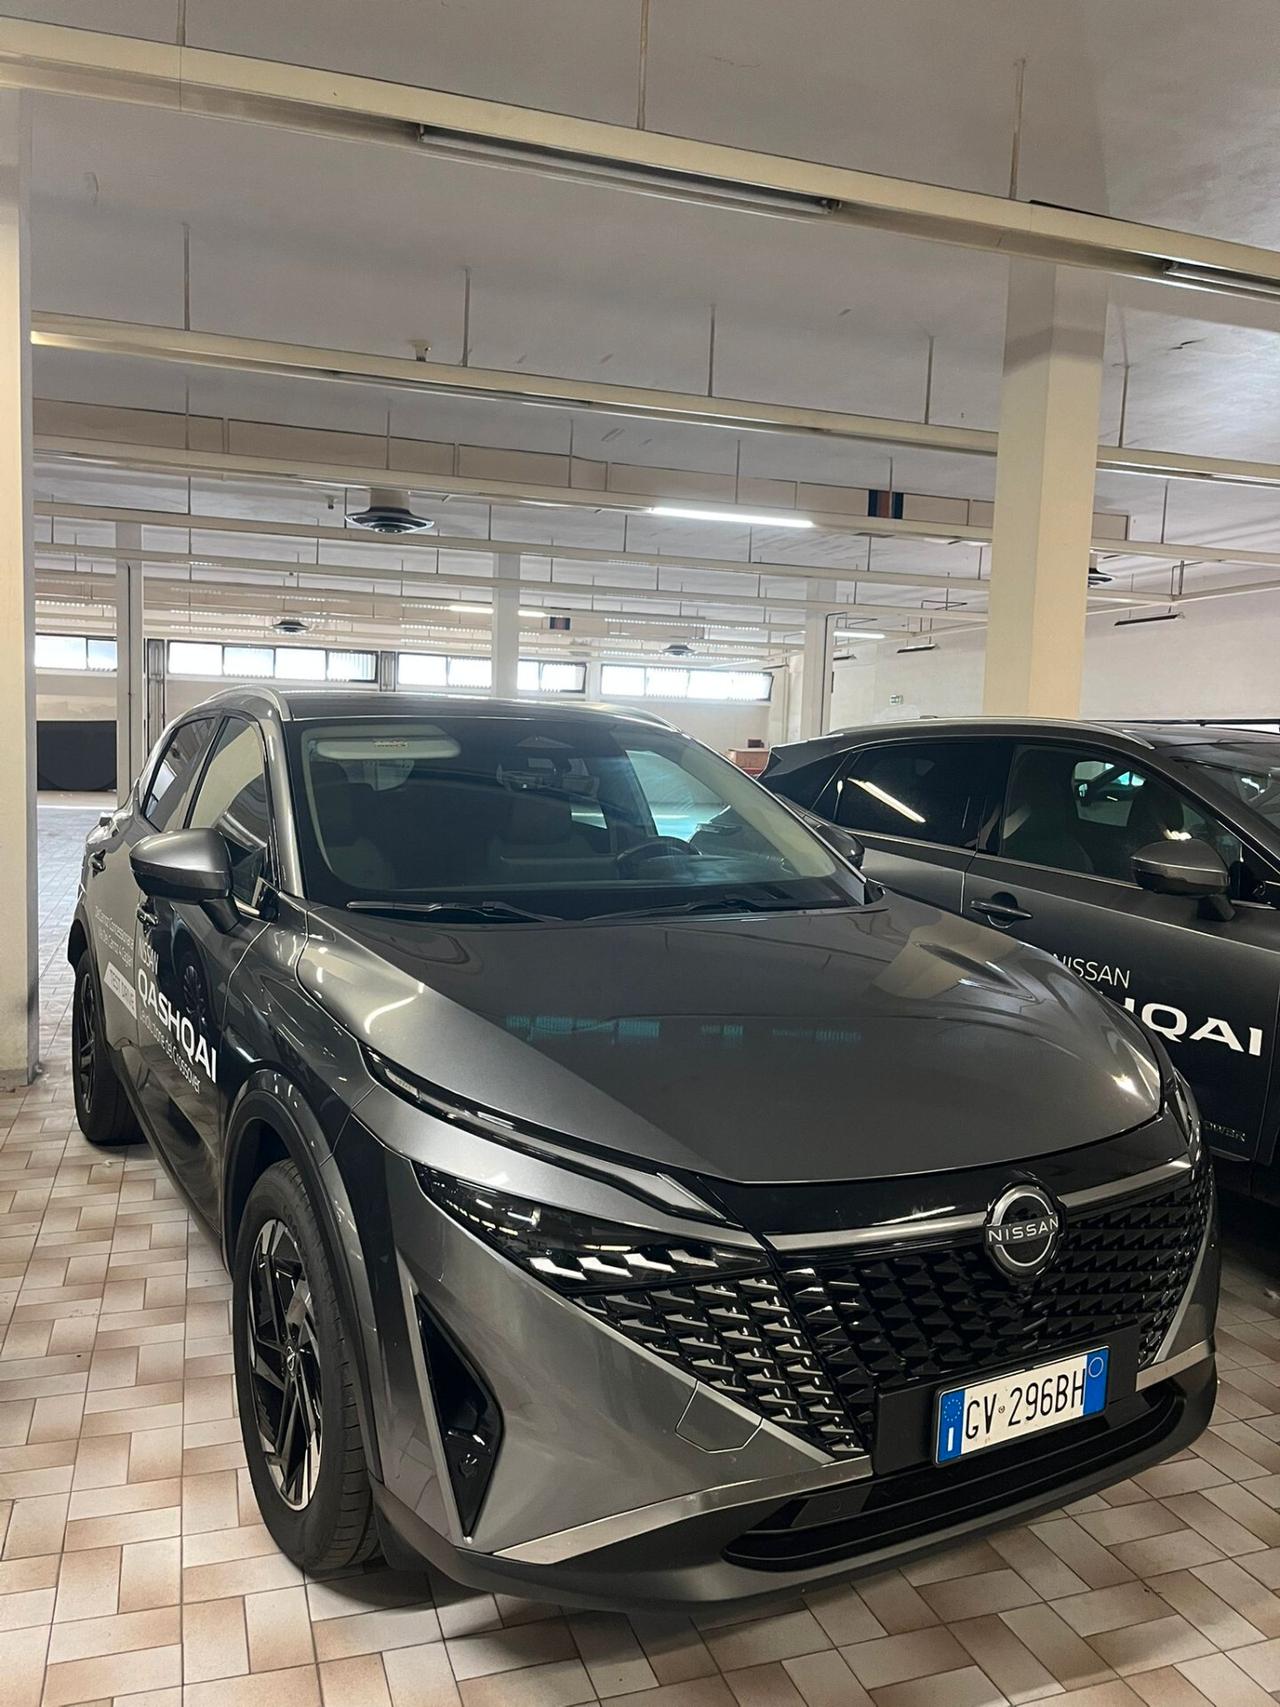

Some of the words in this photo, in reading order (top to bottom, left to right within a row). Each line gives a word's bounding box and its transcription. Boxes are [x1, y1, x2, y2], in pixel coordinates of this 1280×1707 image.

[138, 967, 217, 1084] QASHQAI
[988, 1214, 1059, 1243] NISSAN
[965, 1393, 997, 1439] GV
[1008, 1368, 1086, 1427] 296BH
